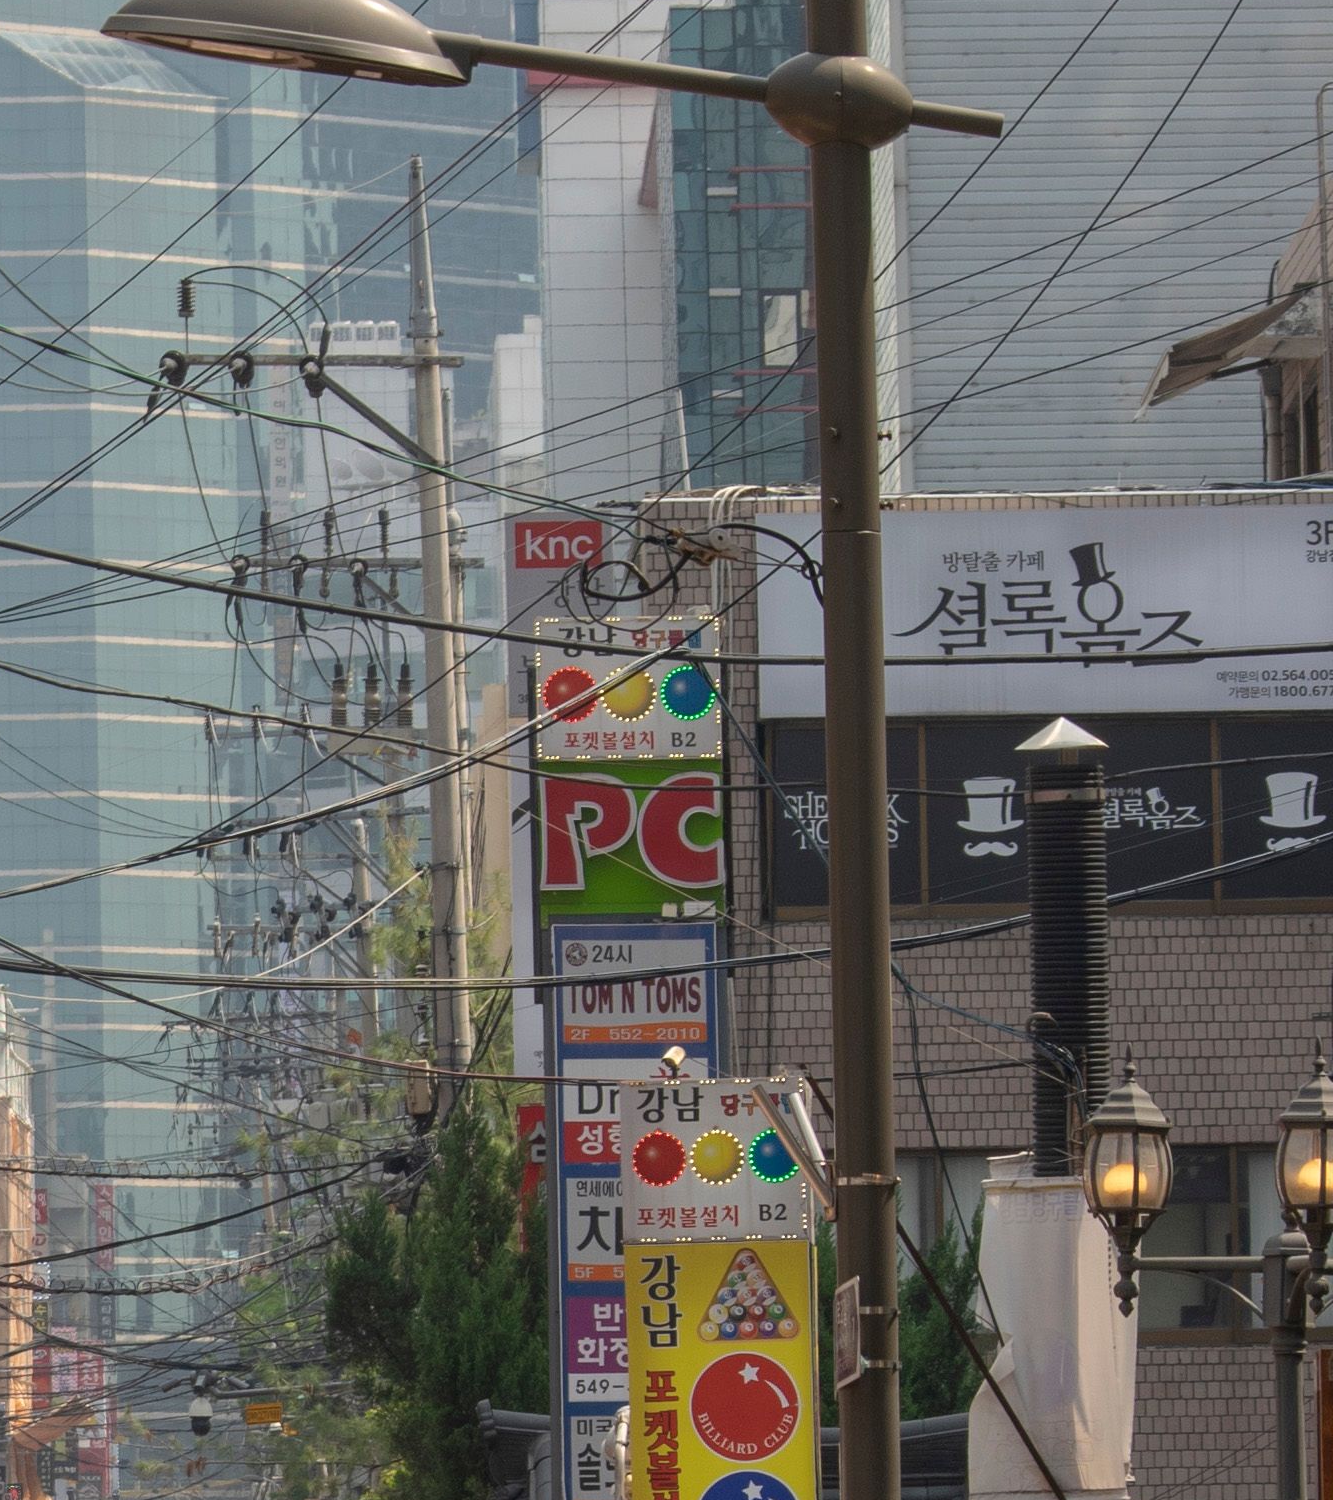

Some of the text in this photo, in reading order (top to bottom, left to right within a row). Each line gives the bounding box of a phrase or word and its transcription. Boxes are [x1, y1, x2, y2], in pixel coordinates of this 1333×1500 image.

[524, 528, 594, 562] knc
[941, 550, 1046, 575] 방탈출 카페
[563, 730, 698, 750] 포켓볼설치 B2
[540, 770, 727, 891] PC
[591, 943, 633, 965] 24시
[569, 976, 702, 1015] TOM N TOMS
[570, 1028, 591, 1041] 2F
[636, 1087, 704, 1123] 강남
[636, 1203, 788, 1230] 포켓볼설치 B2
[639, 1253, 684, 1349] 강남
[696, 1411, 795, 1456] BILLIARD CLUB
